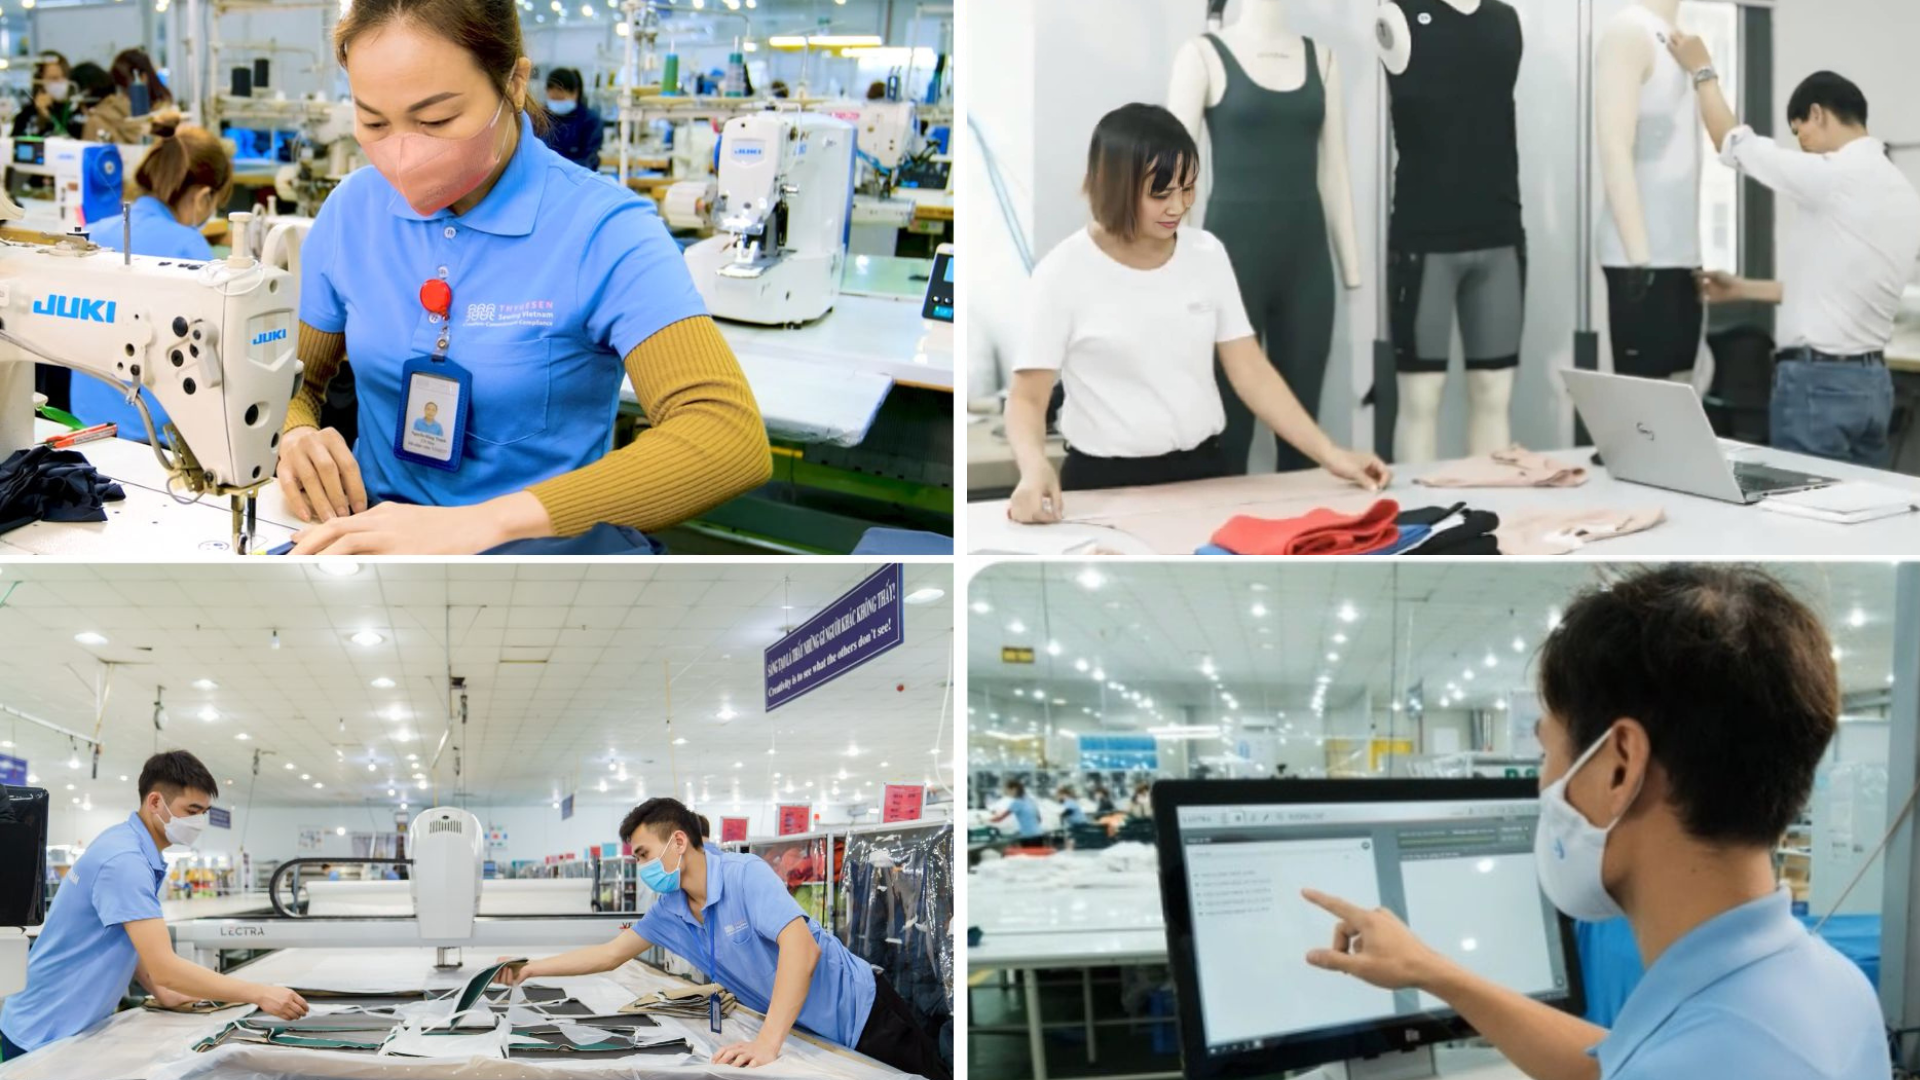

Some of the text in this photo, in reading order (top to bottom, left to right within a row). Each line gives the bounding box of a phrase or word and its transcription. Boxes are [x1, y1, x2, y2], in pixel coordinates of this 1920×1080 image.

[33, 294, 117, 324] JUKI
[522, 310, 554, 319] Vietnam
[252, 328, 287, 345] JUKI
[803, 668, 812, 679] see
[812, 658, 826, 673] what
[826, 653, 837, 666] the
[837, 641, 857, 659] others
[877, 617, 891, 637] see!
[220, 926, 265, 936] LECTRA
